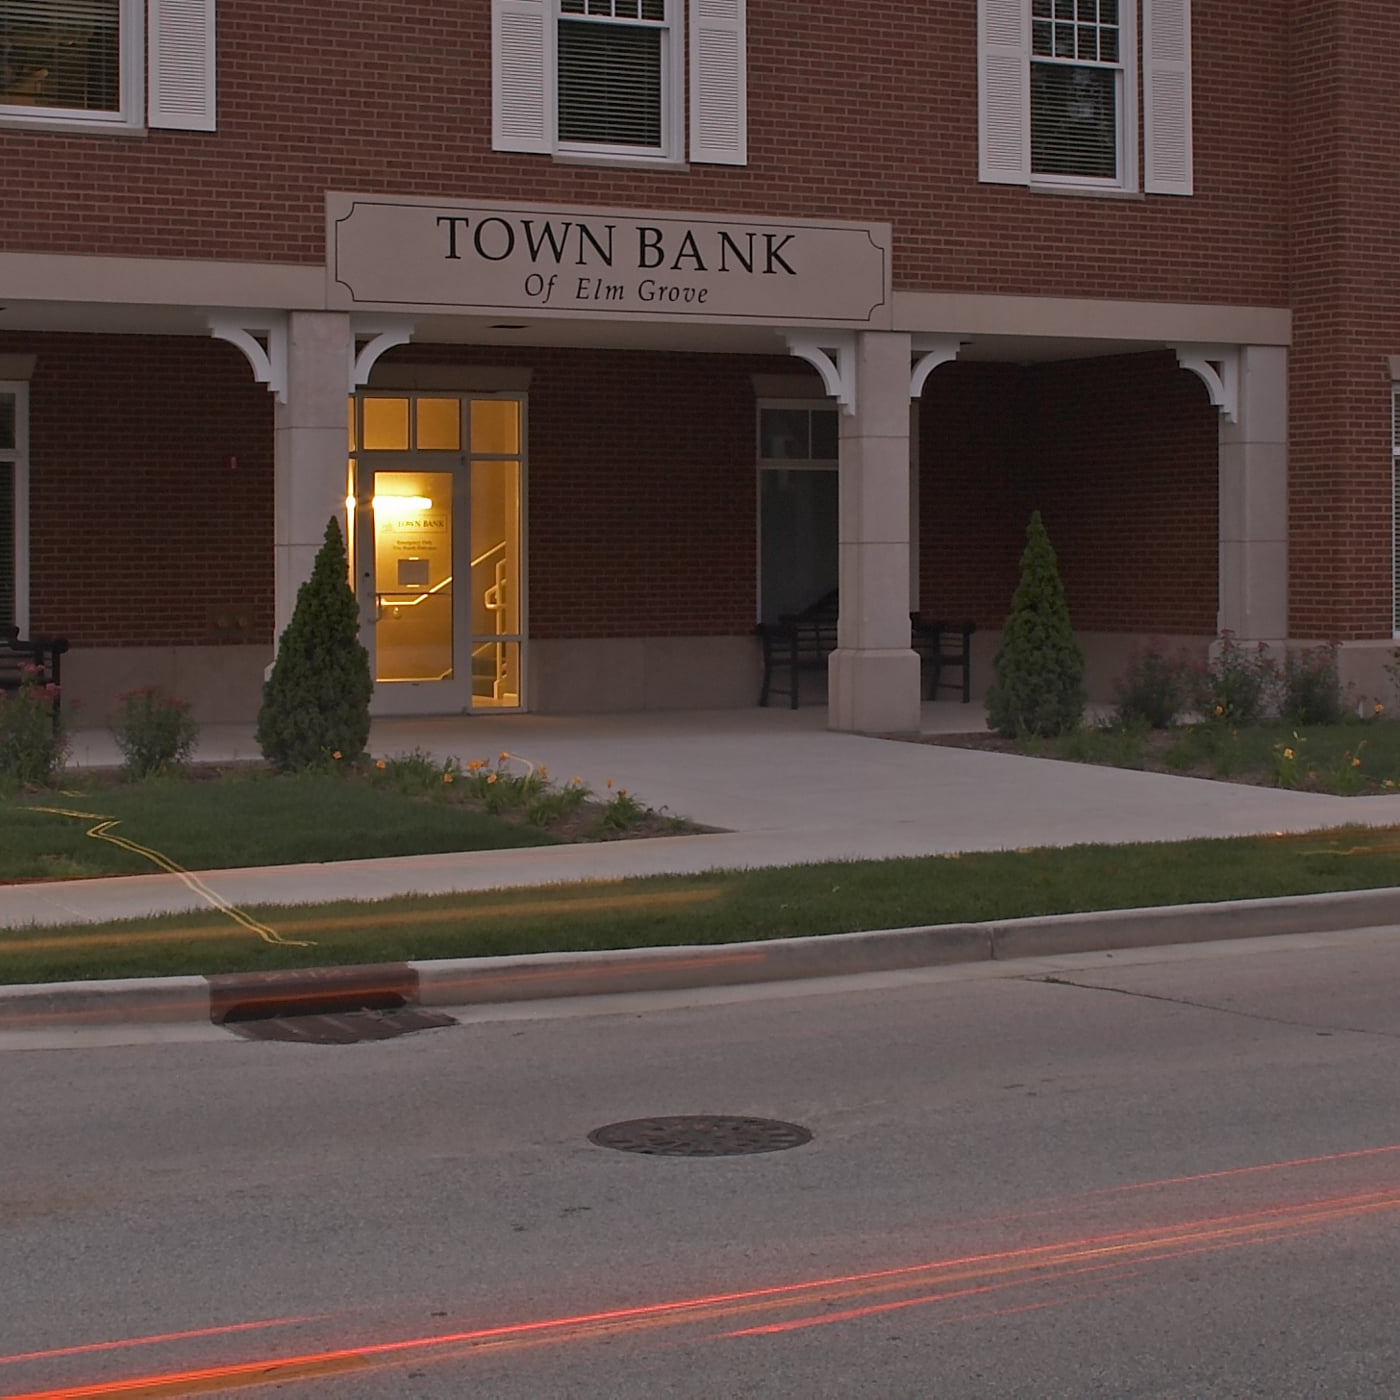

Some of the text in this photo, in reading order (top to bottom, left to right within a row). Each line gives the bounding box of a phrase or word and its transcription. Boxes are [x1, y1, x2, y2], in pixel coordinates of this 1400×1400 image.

[436, 216, 798, 276] TOWN BANK
[525, 273, 709, 304] Of Elm Grove
[423, 520, 445, 528] BANK
